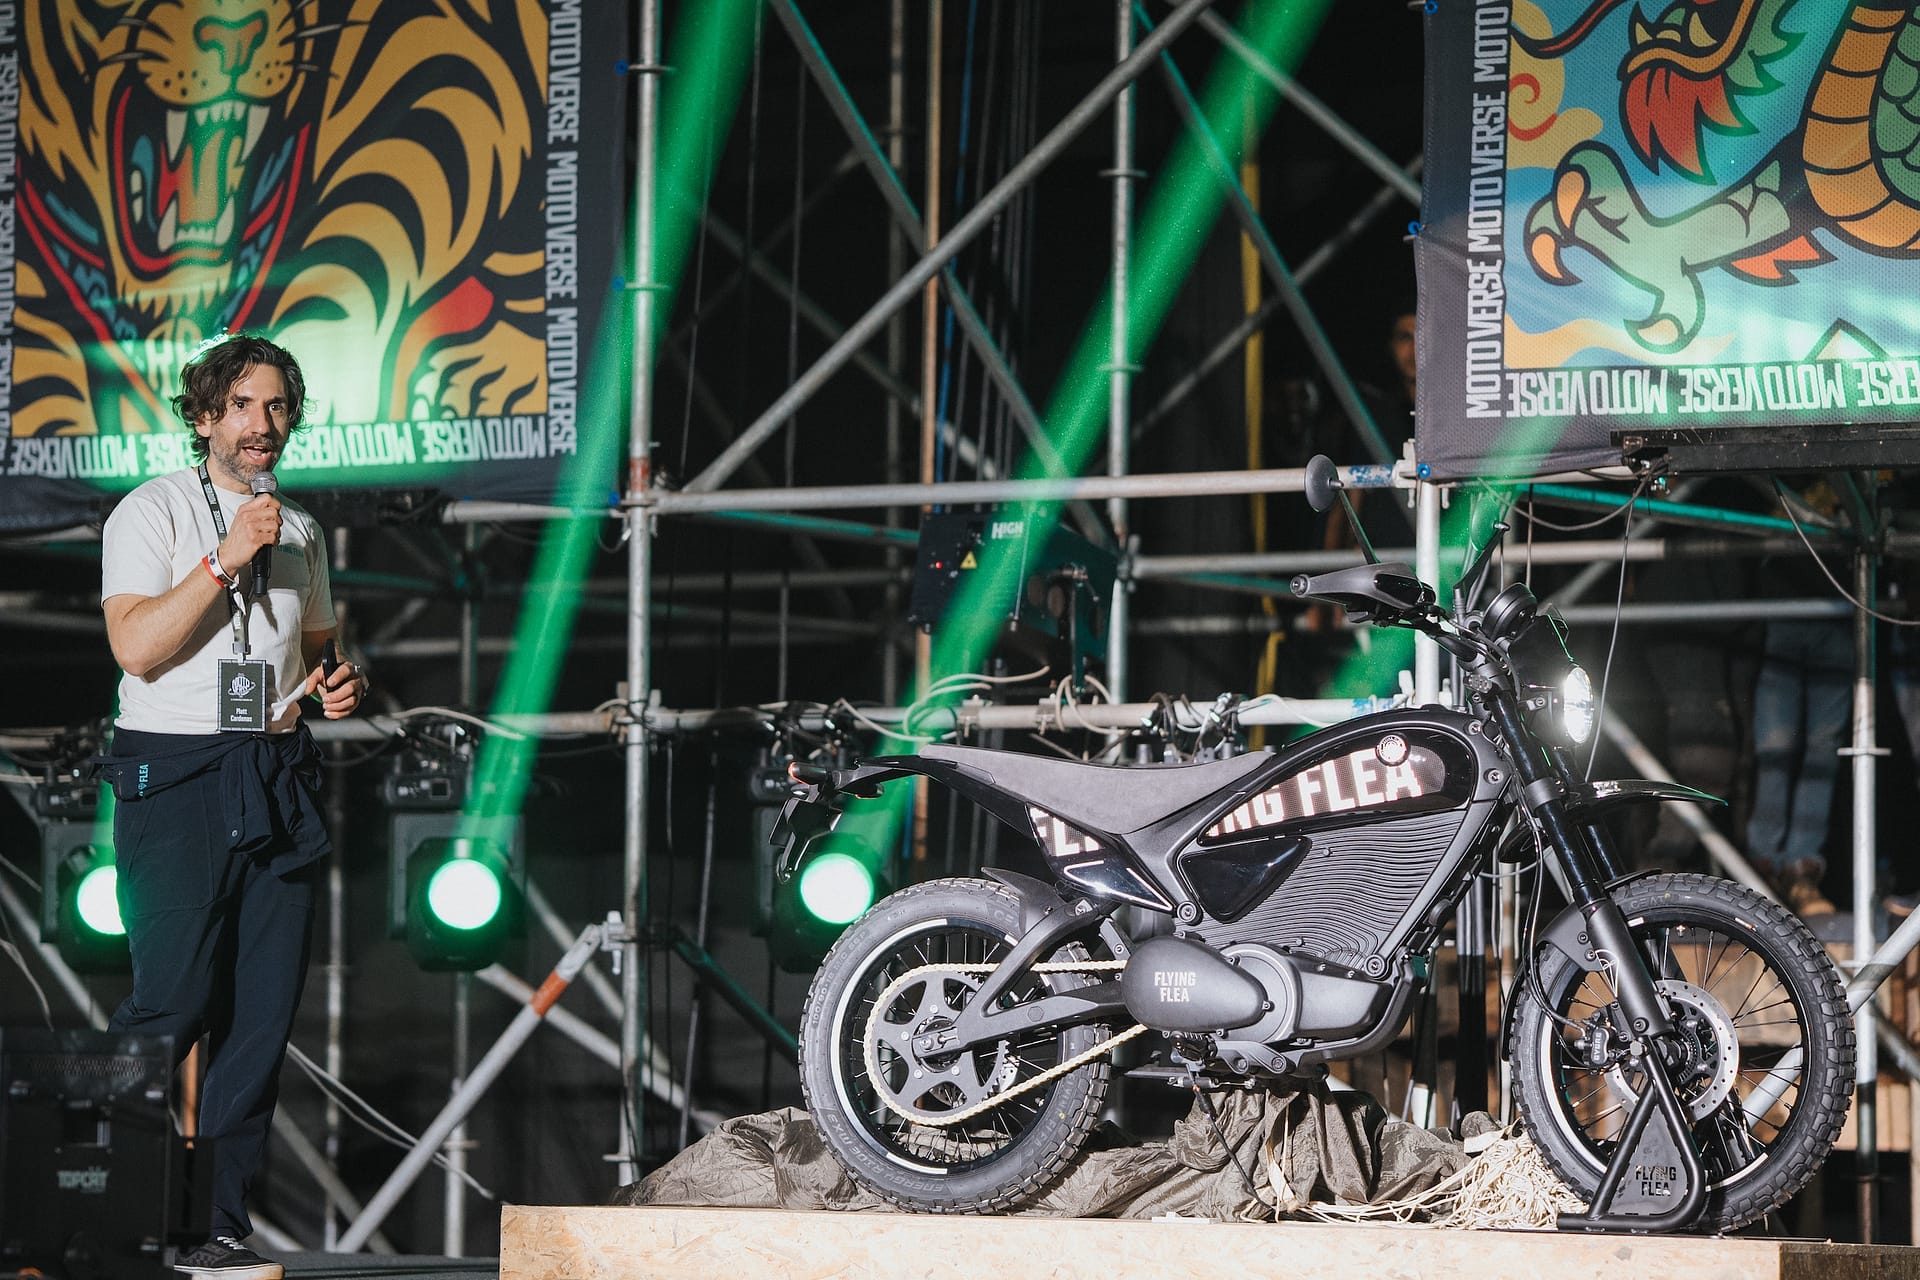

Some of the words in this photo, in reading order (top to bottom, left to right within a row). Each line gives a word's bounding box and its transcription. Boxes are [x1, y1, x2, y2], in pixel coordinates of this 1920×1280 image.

[1473, 0, 1509, 82] MOTO
[547, 0, 581, 144] MOTOVERSE
[1467, 91, 1506, 252] MOTOVERSE
[545, 150, 578, 301] MOTOVERSE
[1466, 259, 1505, 418] MOTOVERSE
[546, 307, 578, 457] MOTOVERSE
[1506, 369, 1668, 418] MOTOVERSE
[1678, 363, 1846, 413] MOTOVERSE
[1852, 361, 1920, 406] ERSE
[7, 434, 139, 479] MOTOVERSE
[282, 421, 416, 470] MOTOVERSE
[418, 416, 548, 463] MOTOVERSE
[991, 521, 1024, 539] HIGH
[138, 764, 149, 783] FLEA
[1297, 746, 1422, 817] FLEA
[1154, 971, 1197, 987] FLYING
[1160, 987, 1190, 1002] FLEA
[1635, 1165, 1678, 1181] FLYING
[1641, 1181, 1672, 1197] FLEA
